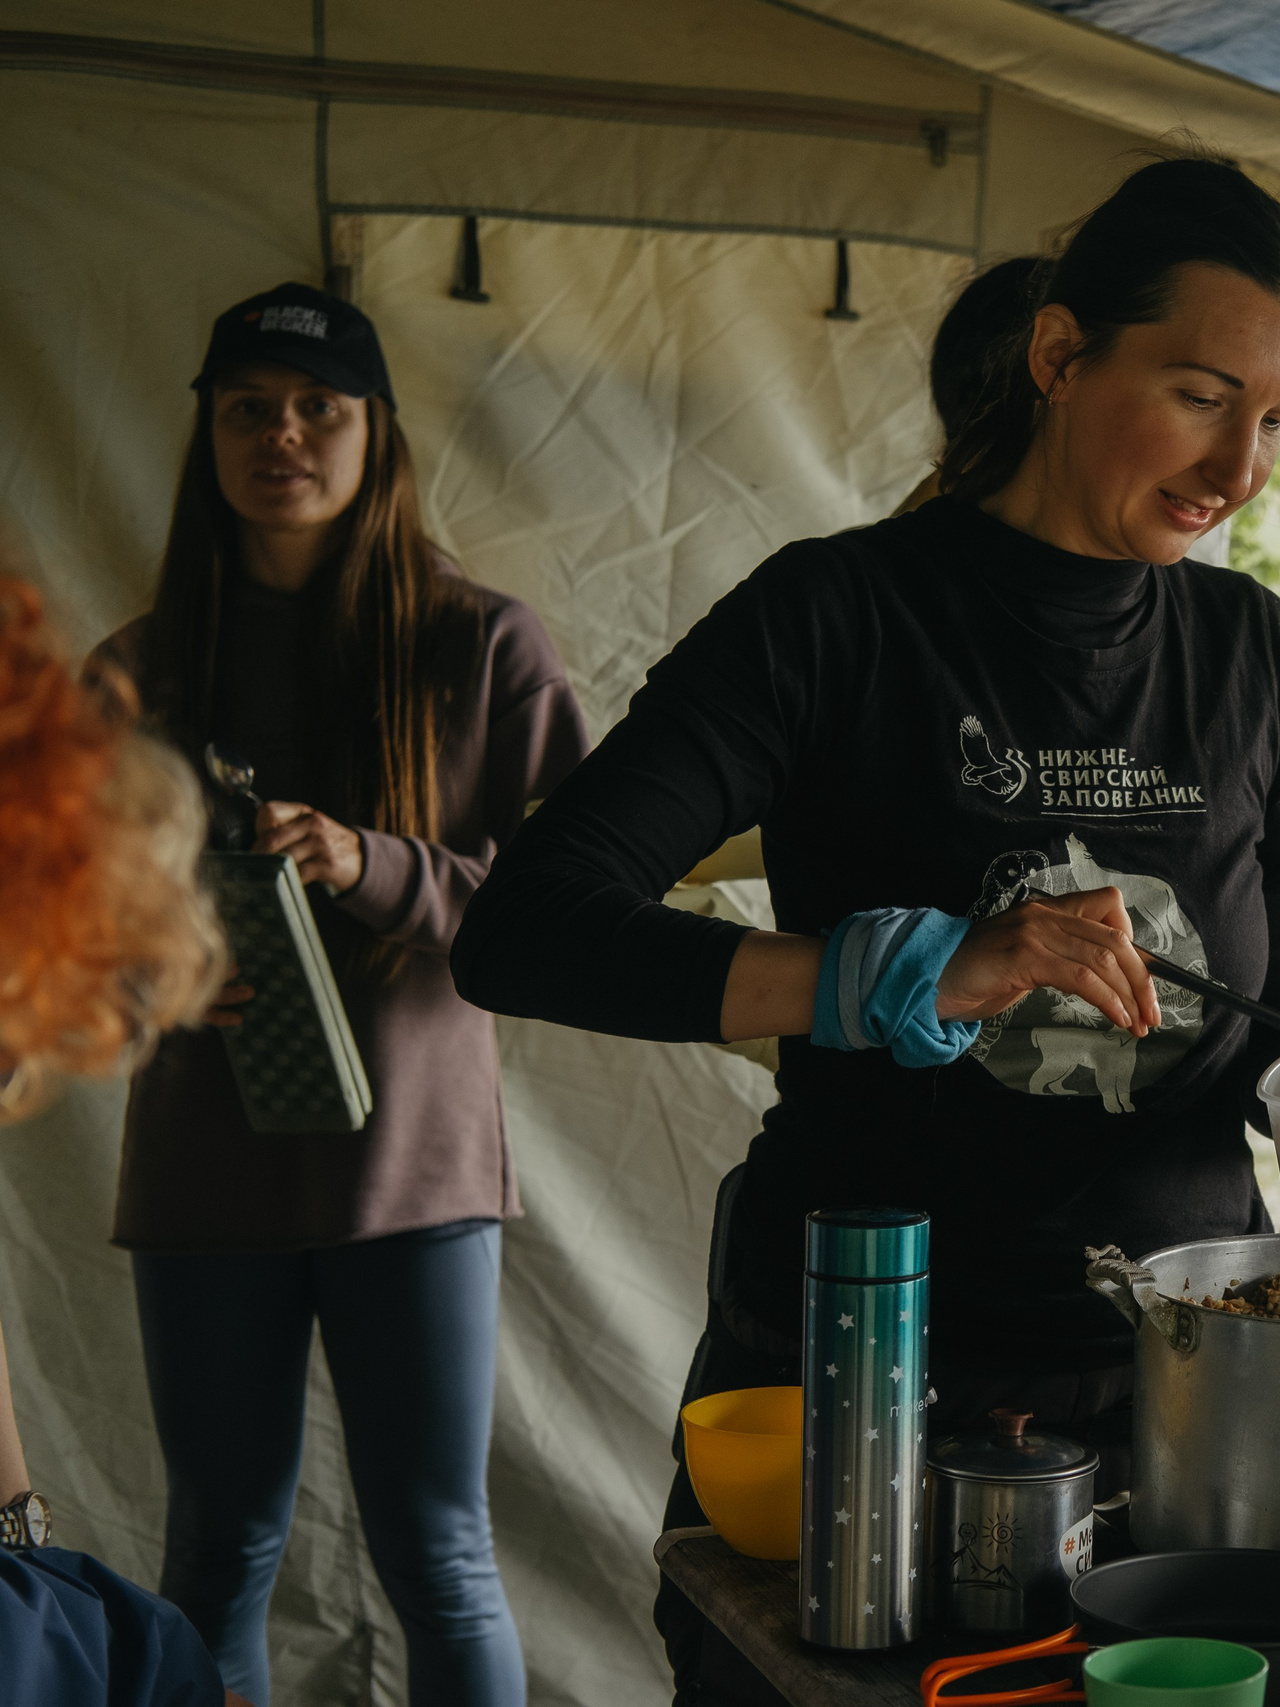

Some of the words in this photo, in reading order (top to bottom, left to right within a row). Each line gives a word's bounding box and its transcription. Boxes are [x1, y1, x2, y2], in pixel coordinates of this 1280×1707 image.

[1038, 748, 1136, 768] НИЖНЕ-
[1040, 765, 1168, 788] СВИРСКИЙ
[1042, 786, 1205, 808] ЗАПОВЕДНИК
